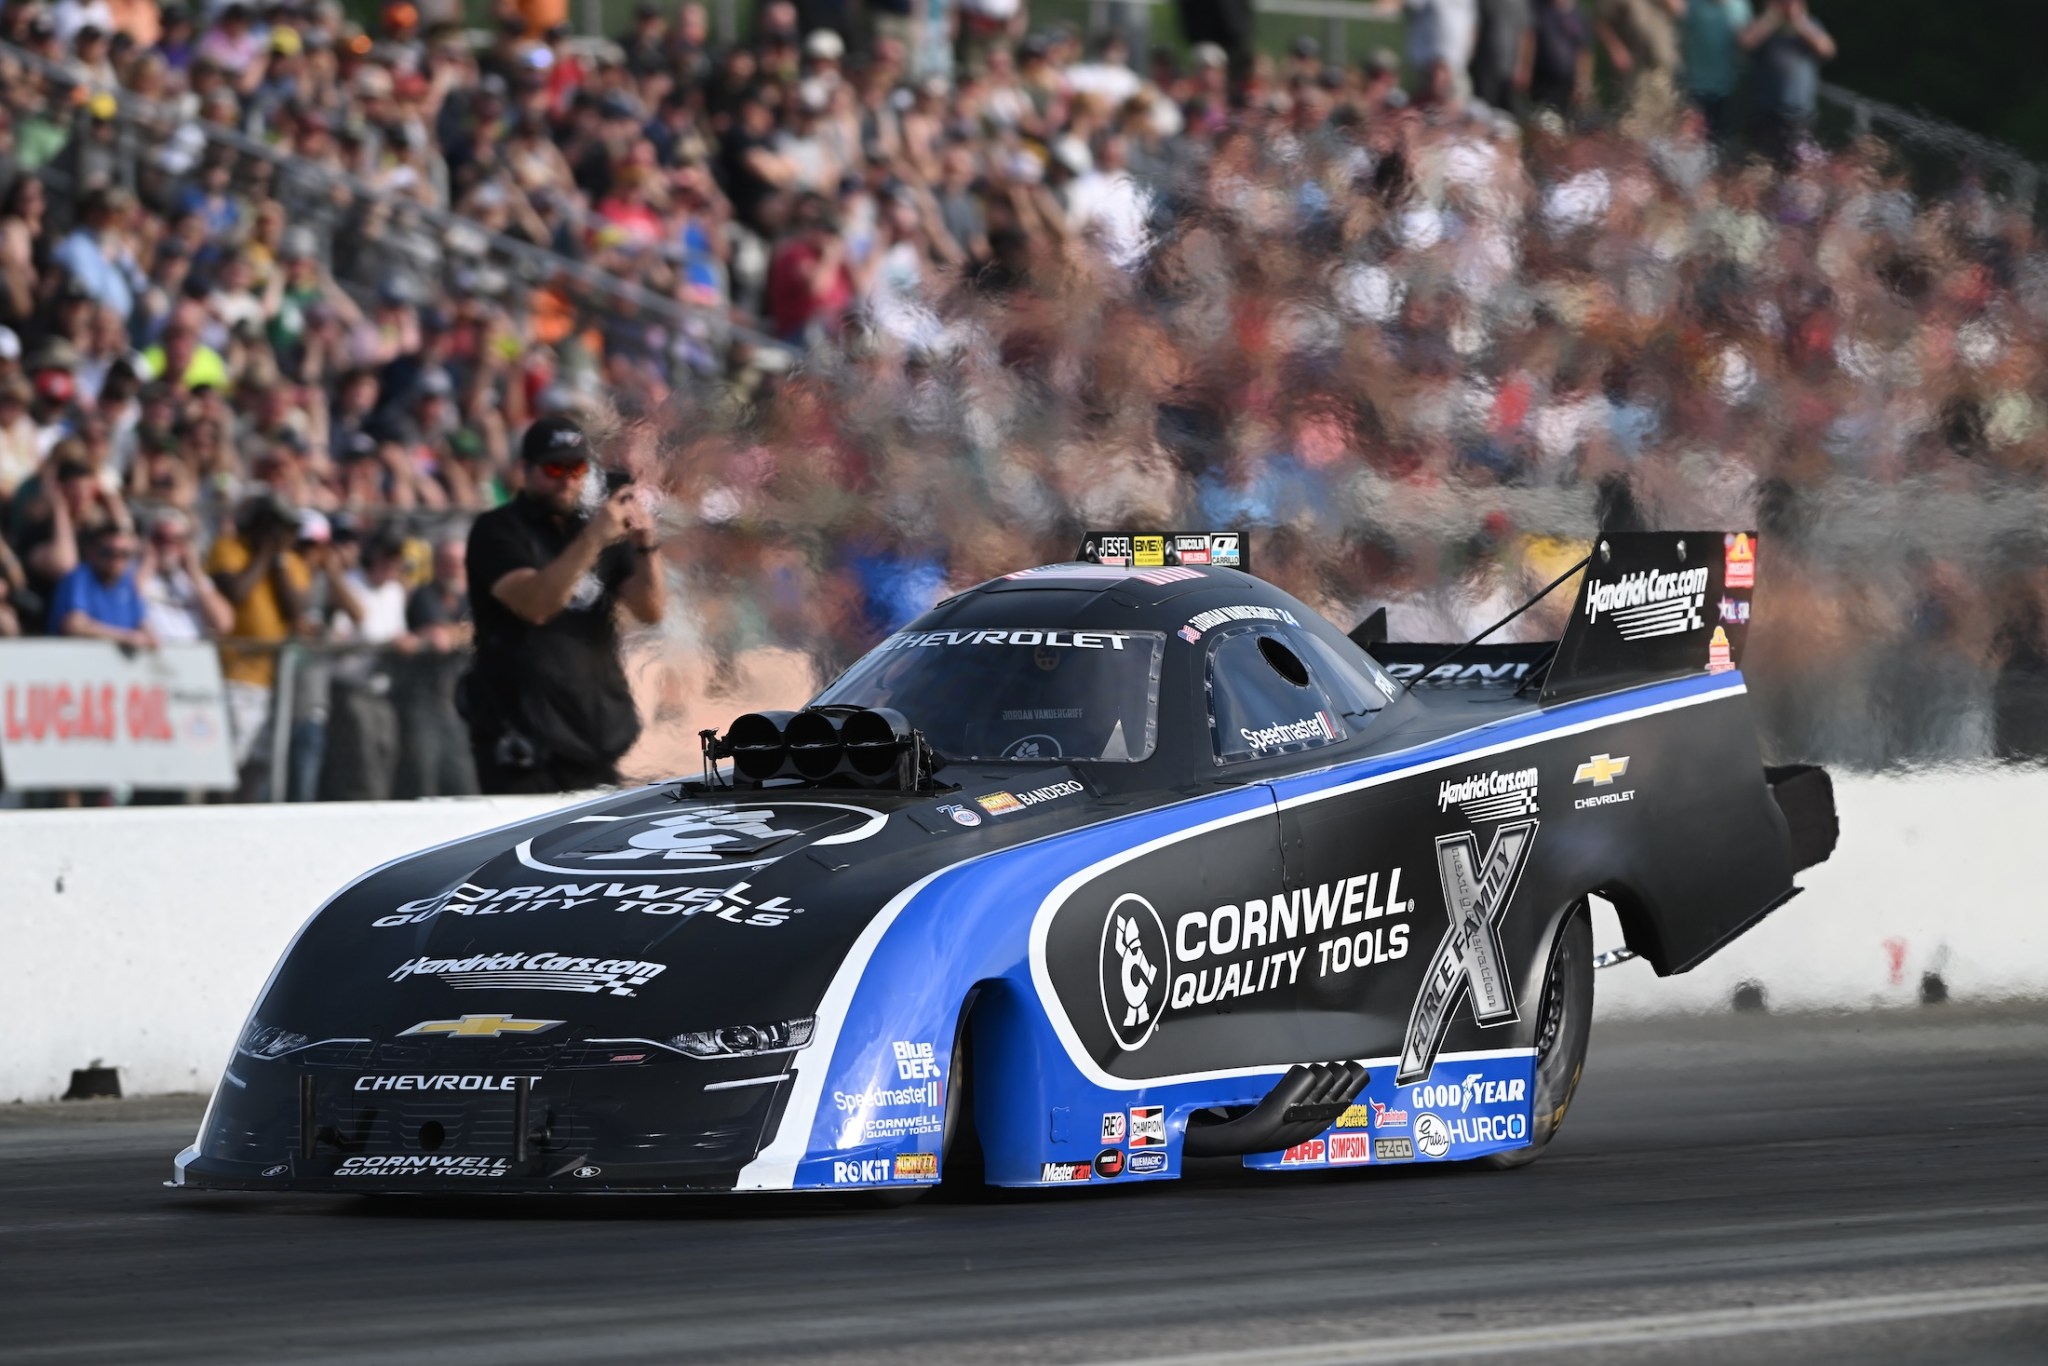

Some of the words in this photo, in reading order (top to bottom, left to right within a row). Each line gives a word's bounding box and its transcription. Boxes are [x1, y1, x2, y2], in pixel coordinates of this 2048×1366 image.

[1100, 538, 1131, 557] JESEL
[1177, 538, 1205, 550] LINCOLN
[1183, 552, 1208, 562] WELDERS
[1212, 556, 1239, 564] CARRILLO
[882, 631, 1130, 650] CHEVROLET
[4, 681, 116, 742] LUCAS
[125, 681, 174, 742] OIL
[1002, 708, 1033, 720] JORDAN
[1034, 707, 1083, 719] VANDERGRIFF
[1240, 716, 1324, 752] Speedmaster
[1015, 780, 1084, 806] BANDERO
[1574, 790, 1636, 809] CHEVROLET
[1451, 847, 1469, 895] next
[396, 882, 792, 912] CORNWELL
[371, 898, 598, 926] QUALITY
[614, 899, 790, 926] TOOLS
[1175, 867, 1408, 962] CORNWELL
[1411, 955, 1456, 1063] FORCE
[1452, 841, 1512, 963] FAMILY
[1170, 946, 1307, 1010] QUALITY
[1318, 923, 1410, 977] TOOLS
[892, 1041, 933, 1060] Blue
[897, 1058, 935, 1079] DEF
[834, 1086, 927, 1114] Speedmaster
[865, 1115, 941, 1130] CORNWELL
[865, 1127, 906, 1139] QUALITY
[909, 1124, 941, 1135] TOOLS
[1132, 1120, 1161, 1136] CHAMPION
[1447, 1114, 1526, 1144] HURCO
[1418, 1119, 1450, 1152] Gates
[1284, 1141, 1325, 1160] ARP
[1331, 1137, 1367, 1158] SIMPSON
[333, 1167, 428, 1176] QUALITY
[434, 1167, 507, 1176] TOOLS
[342, 1156, 508, 1168] CORNWELL
